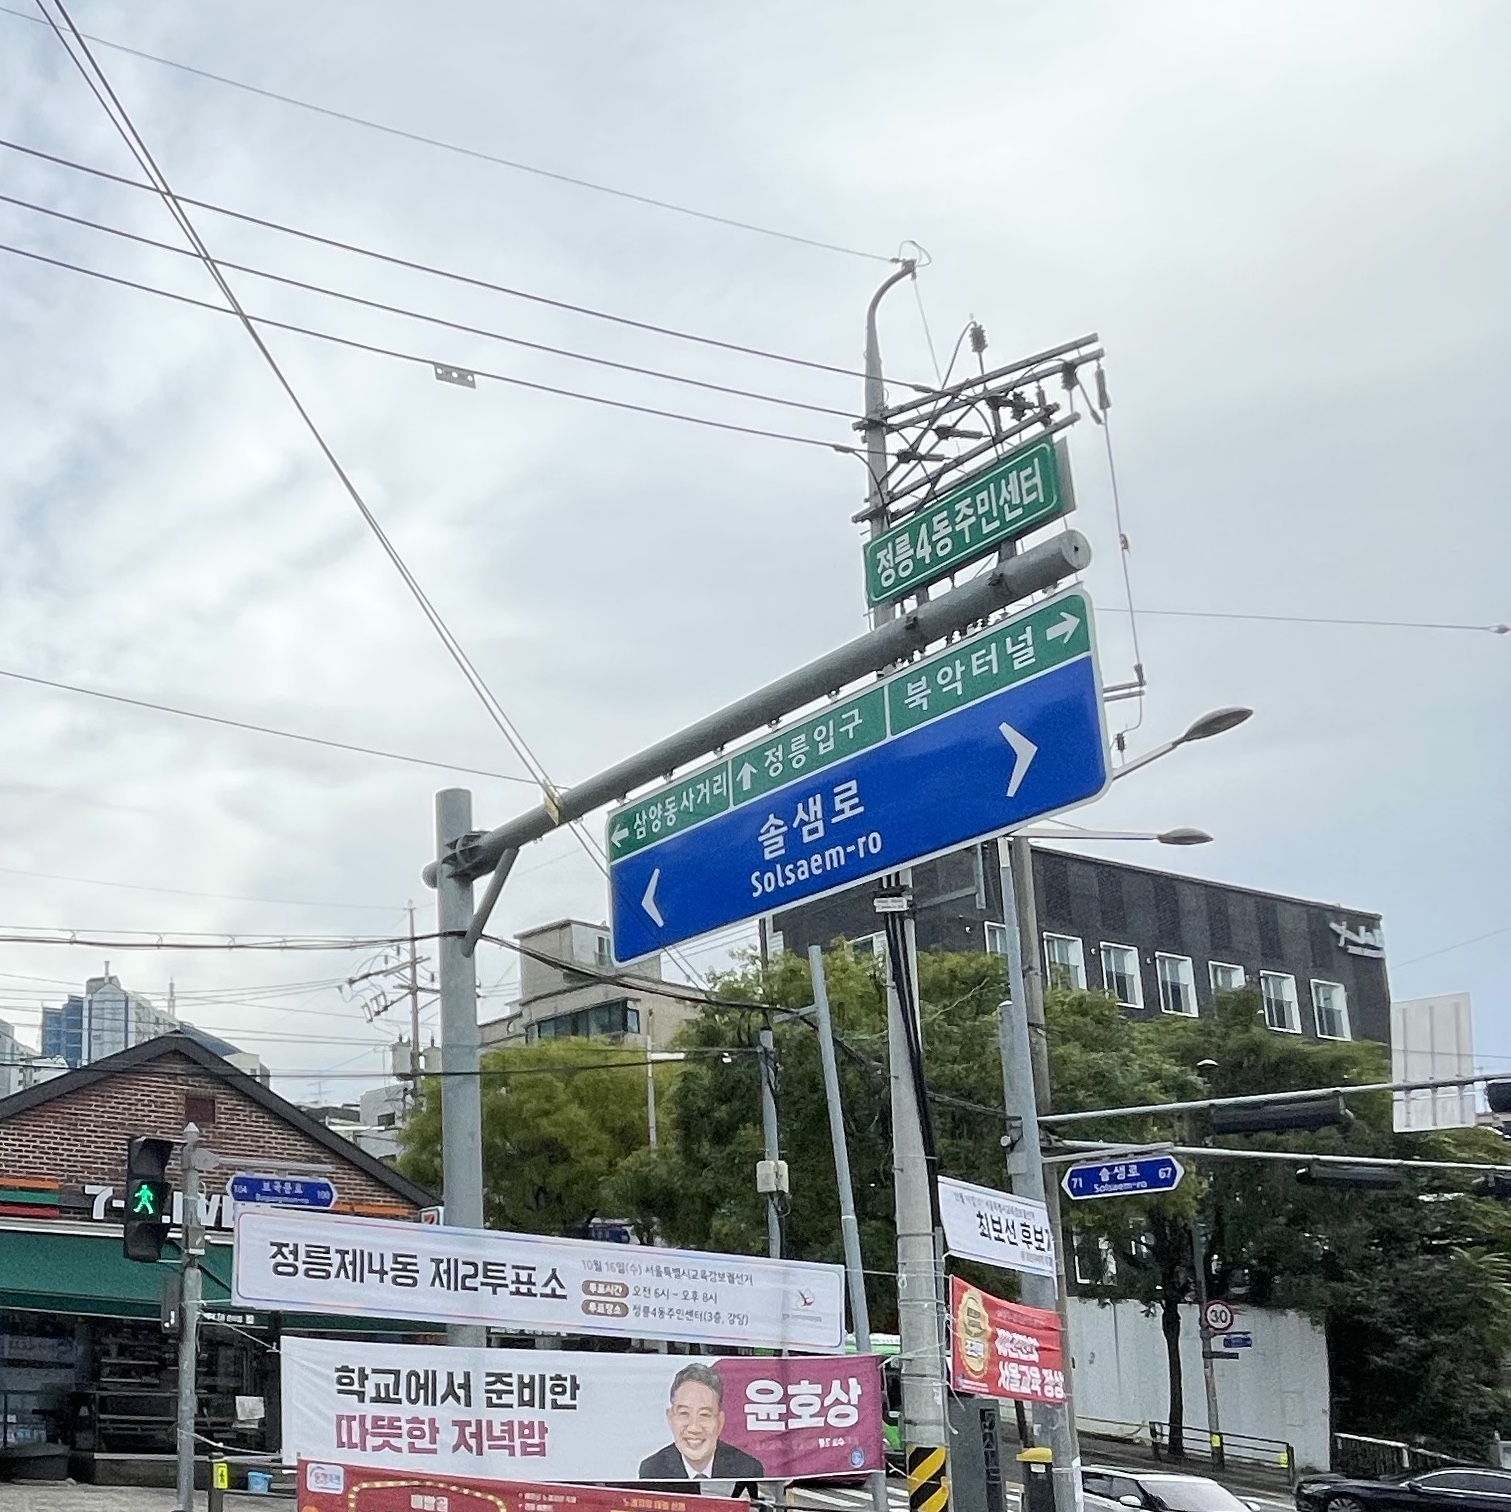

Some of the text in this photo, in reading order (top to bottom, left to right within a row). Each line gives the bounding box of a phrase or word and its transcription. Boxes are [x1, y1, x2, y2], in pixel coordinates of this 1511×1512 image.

[877, 457, 1044, 588] 정릉4동주민센터
[903, 626, 1037, 712] 북악터널
[762, 710, 864, 777] 정릉입구
[632, 772, 730, 840] 삼양동사거리
[756, 779, 865, 861] 솔샘로
[751, 828, 882, 898] Solsaem-ro
[1072, 1178, 1083, 1189] 71
[1158, 1167, 1172, 1179] 67
[976, 1210, 1019, 1247] 최보선
[268, 1241, 568, 1300] 정릉제4동 제2투표소
[582, 1259, 603, 1273] 10월
[632, 1286, 652, 1298] 오전
[654, 1288, 670, 1300] 6시
[682, 1290, 699, 1302] 오후
[702, 1292, 718, 1304] 8시
[1210, 1309, 1228, 1324] 30
[334, 1365, 580, 1410] 학교에서 준비한
[744, 1377, 863, 1431] 윤호상
[335, 1413, 549, 1457] 따뜻한 저녁밥
